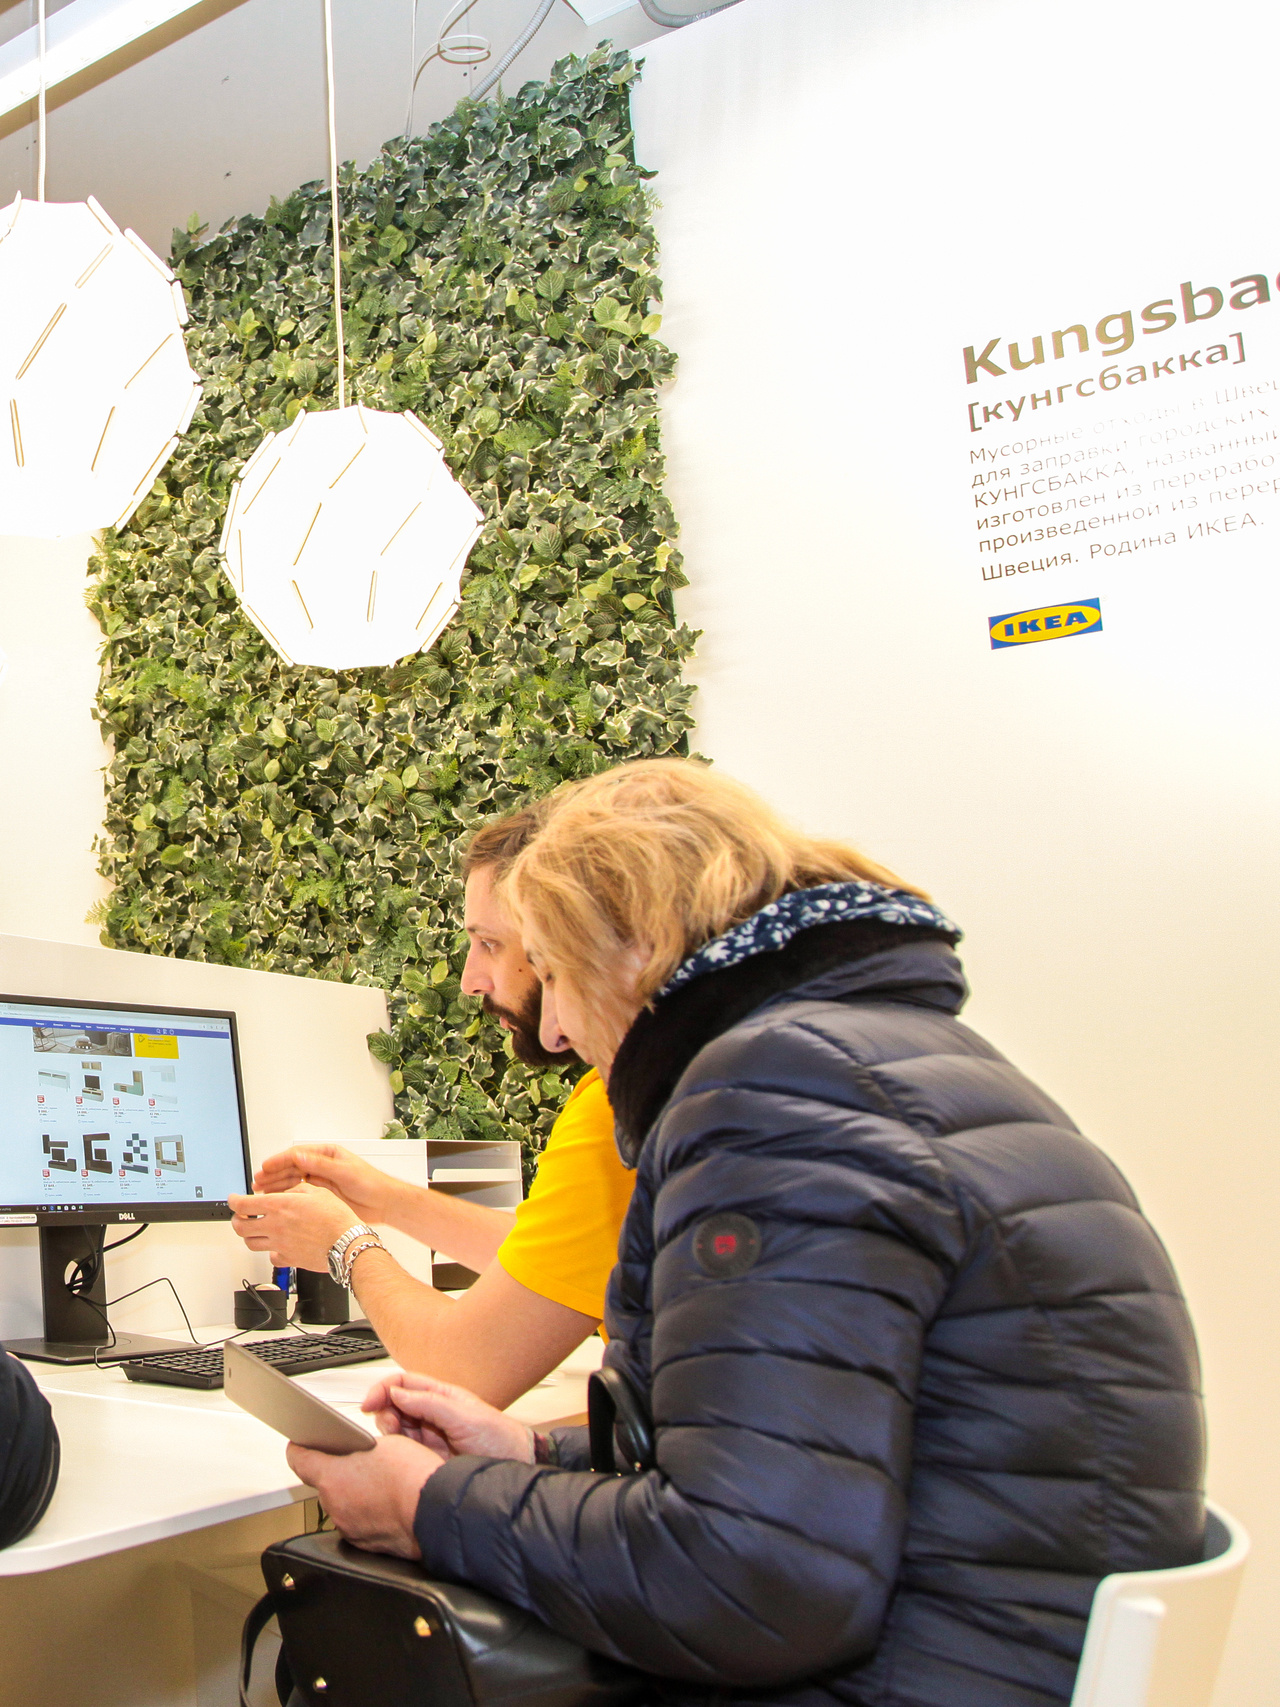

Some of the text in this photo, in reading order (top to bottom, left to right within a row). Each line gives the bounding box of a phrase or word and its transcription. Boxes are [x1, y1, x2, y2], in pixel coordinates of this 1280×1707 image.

[962, 271, 1280, 385] Kungsba
[967, 332, 1246, 432] [кунгсбакка]
[970, 427, 1084, 464] Мусорные
[971, 467, 1011, 489] для
[1020, 440, 1128, 476] заправки
[977, 491, 1106, 530] изготовлен
[1116, 483, 1142, 500] из
[979, 501, 1160, 553] произведенной
[1171, 495, 1198, 512] из
[981, 512, 1265, 581] Швеция. Родина ИКЕА.
[1004, 611, 1089, 637] IKEA
[118, 1212, 136, 1221] DELL
